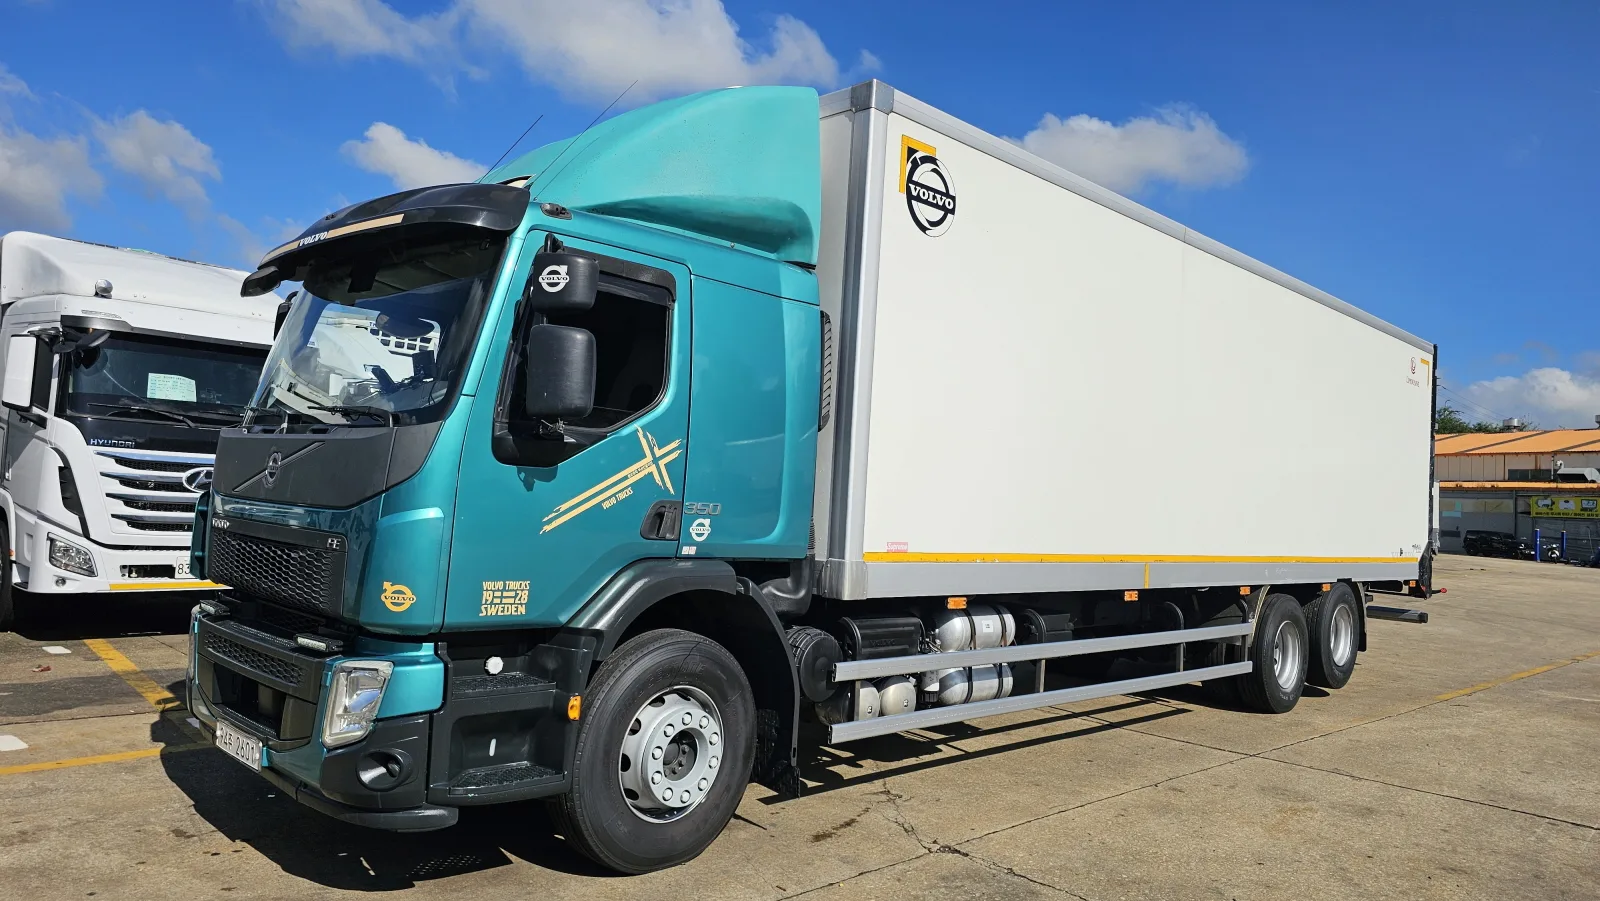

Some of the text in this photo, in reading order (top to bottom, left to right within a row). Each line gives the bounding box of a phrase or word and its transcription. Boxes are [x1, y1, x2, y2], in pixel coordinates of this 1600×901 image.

[908, 183, 954, 210] VOLVO
[299, 231, 328, 246] VOLVO
[90, 438, 135, 448] HYUNDAI
[602, 487, 634, 510] VOLVO TRUCKS
[684, 501, 721, 515] 350
[482, 580, 531, 590] VOLVO TRUCKS
[478, 604, 526, 616] SWEDEN
[236, 737, 255, 764] 2601
